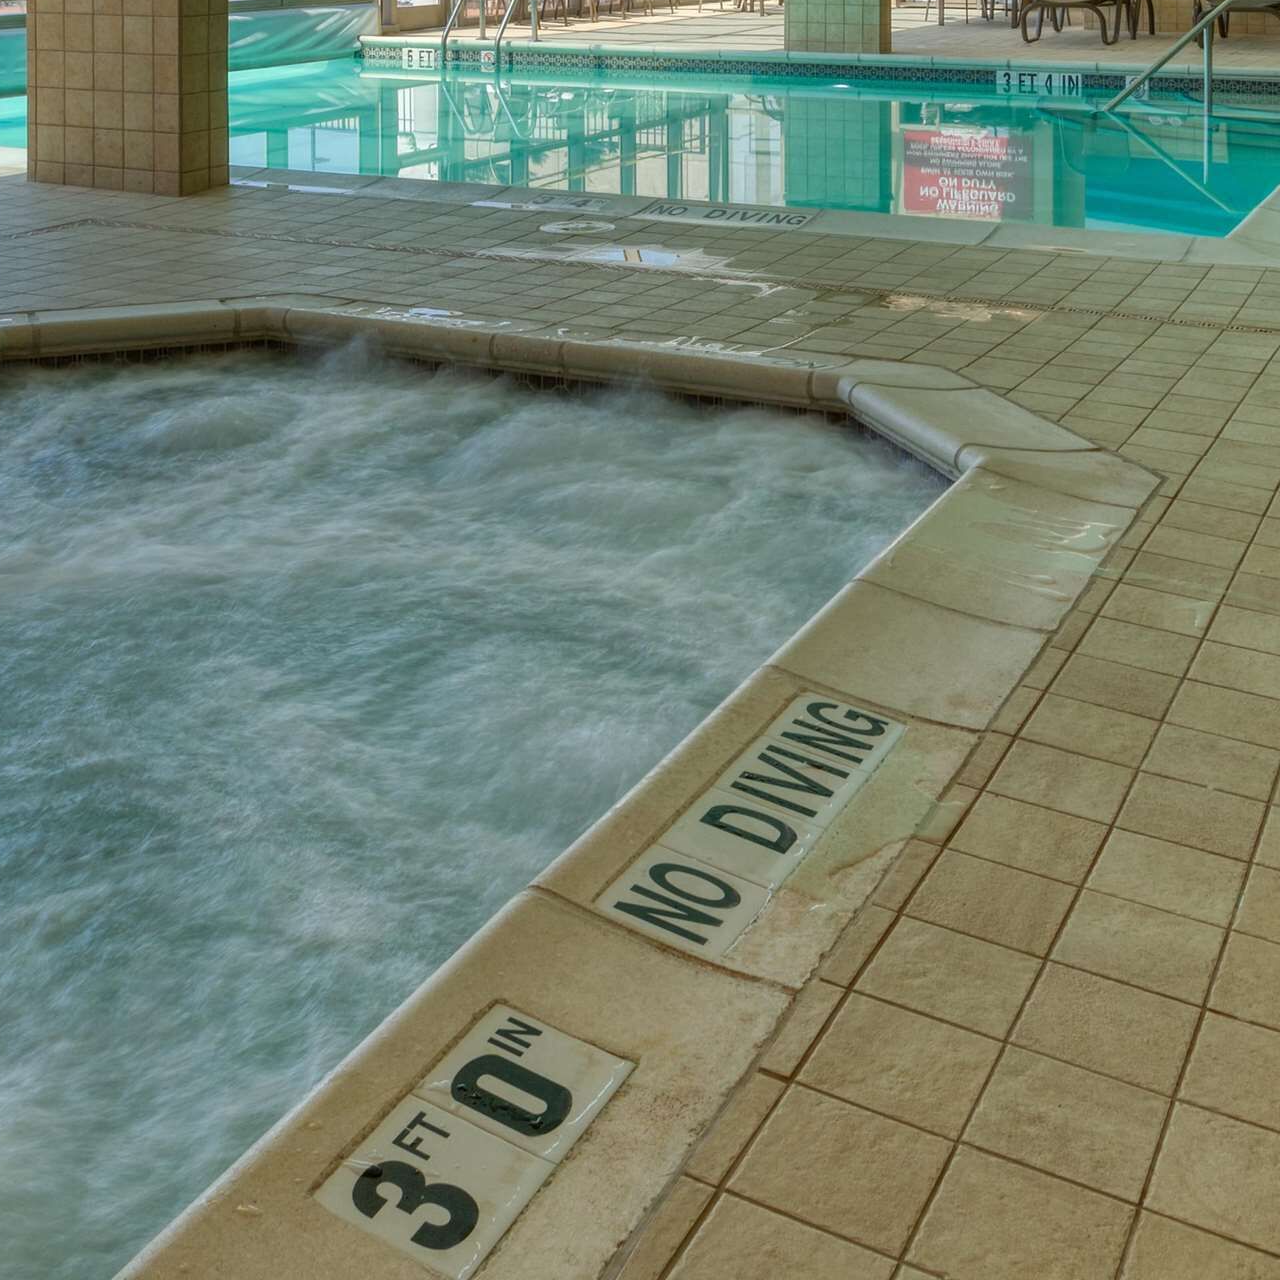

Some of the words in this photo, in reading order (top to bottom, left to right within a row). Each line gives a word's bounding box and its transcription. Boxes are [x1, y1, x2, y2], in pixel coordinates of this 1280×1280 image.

[650, 204, 688, 217] NO
[704, 208, 808, 226] DIVING
[613, 862, 742, 946] NO
[699, 701, 889, 854] DIVING
[487, 1016, 544, 1058] IN
[450, 1053, 573, 1138] 0
[392, 1111, 452, 1162] FT
[352, 1160, 480, 1251] 3
